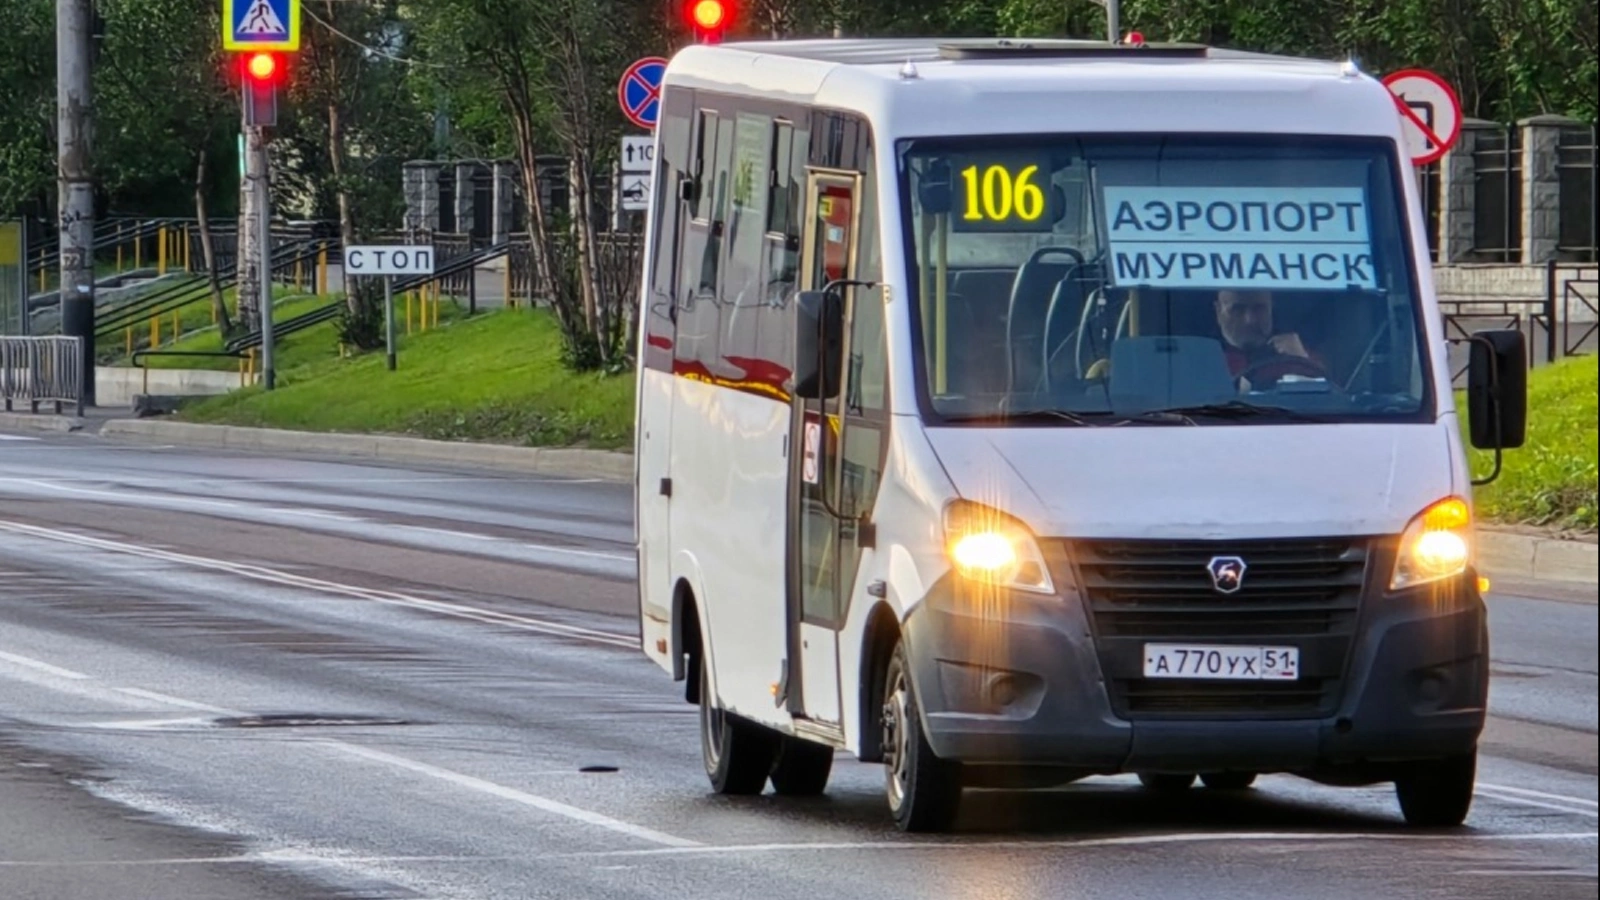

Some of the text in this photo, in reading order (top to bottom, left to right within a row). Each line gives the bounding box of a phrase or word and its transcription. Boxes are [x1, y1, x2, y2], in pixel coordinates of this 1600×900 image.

[961, 165, 1044, 220] 106
[1112, 201, 1362, 232] АЭРОПОРТ
[348, 250, 430, 269] СТОП
[1116, 252, 1372, 281] МУРМАНСК
[1265, 650, 1289, 669] 51
